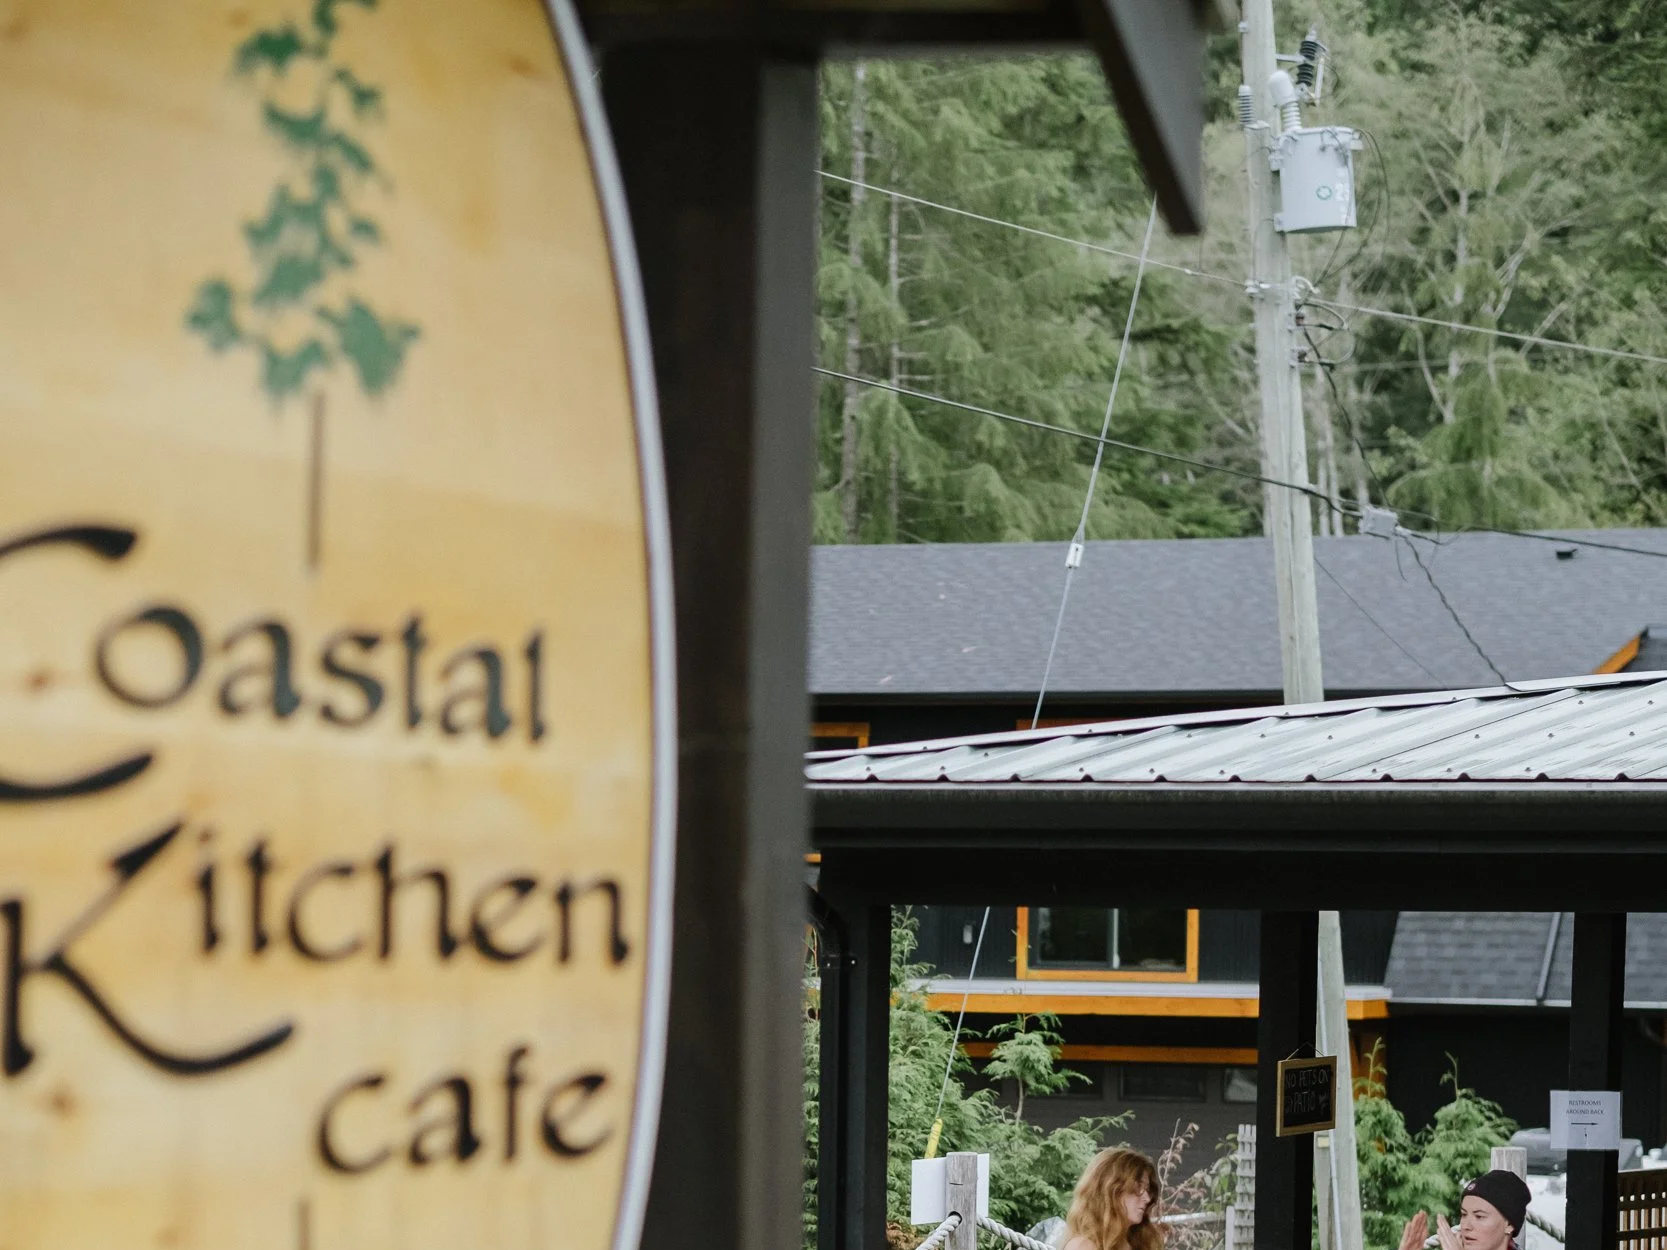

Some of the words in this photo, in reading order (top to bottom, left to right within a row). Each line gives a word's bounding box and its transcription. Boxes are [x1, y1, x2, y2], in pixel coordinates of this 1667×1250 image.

[0, 820, 632, 1076] Kitchen
[315, 1043, 612, 1176] cafe
[1285, 1072, 1296, 1088] NO
[1298, 1069, 1318, 1087] PETS
